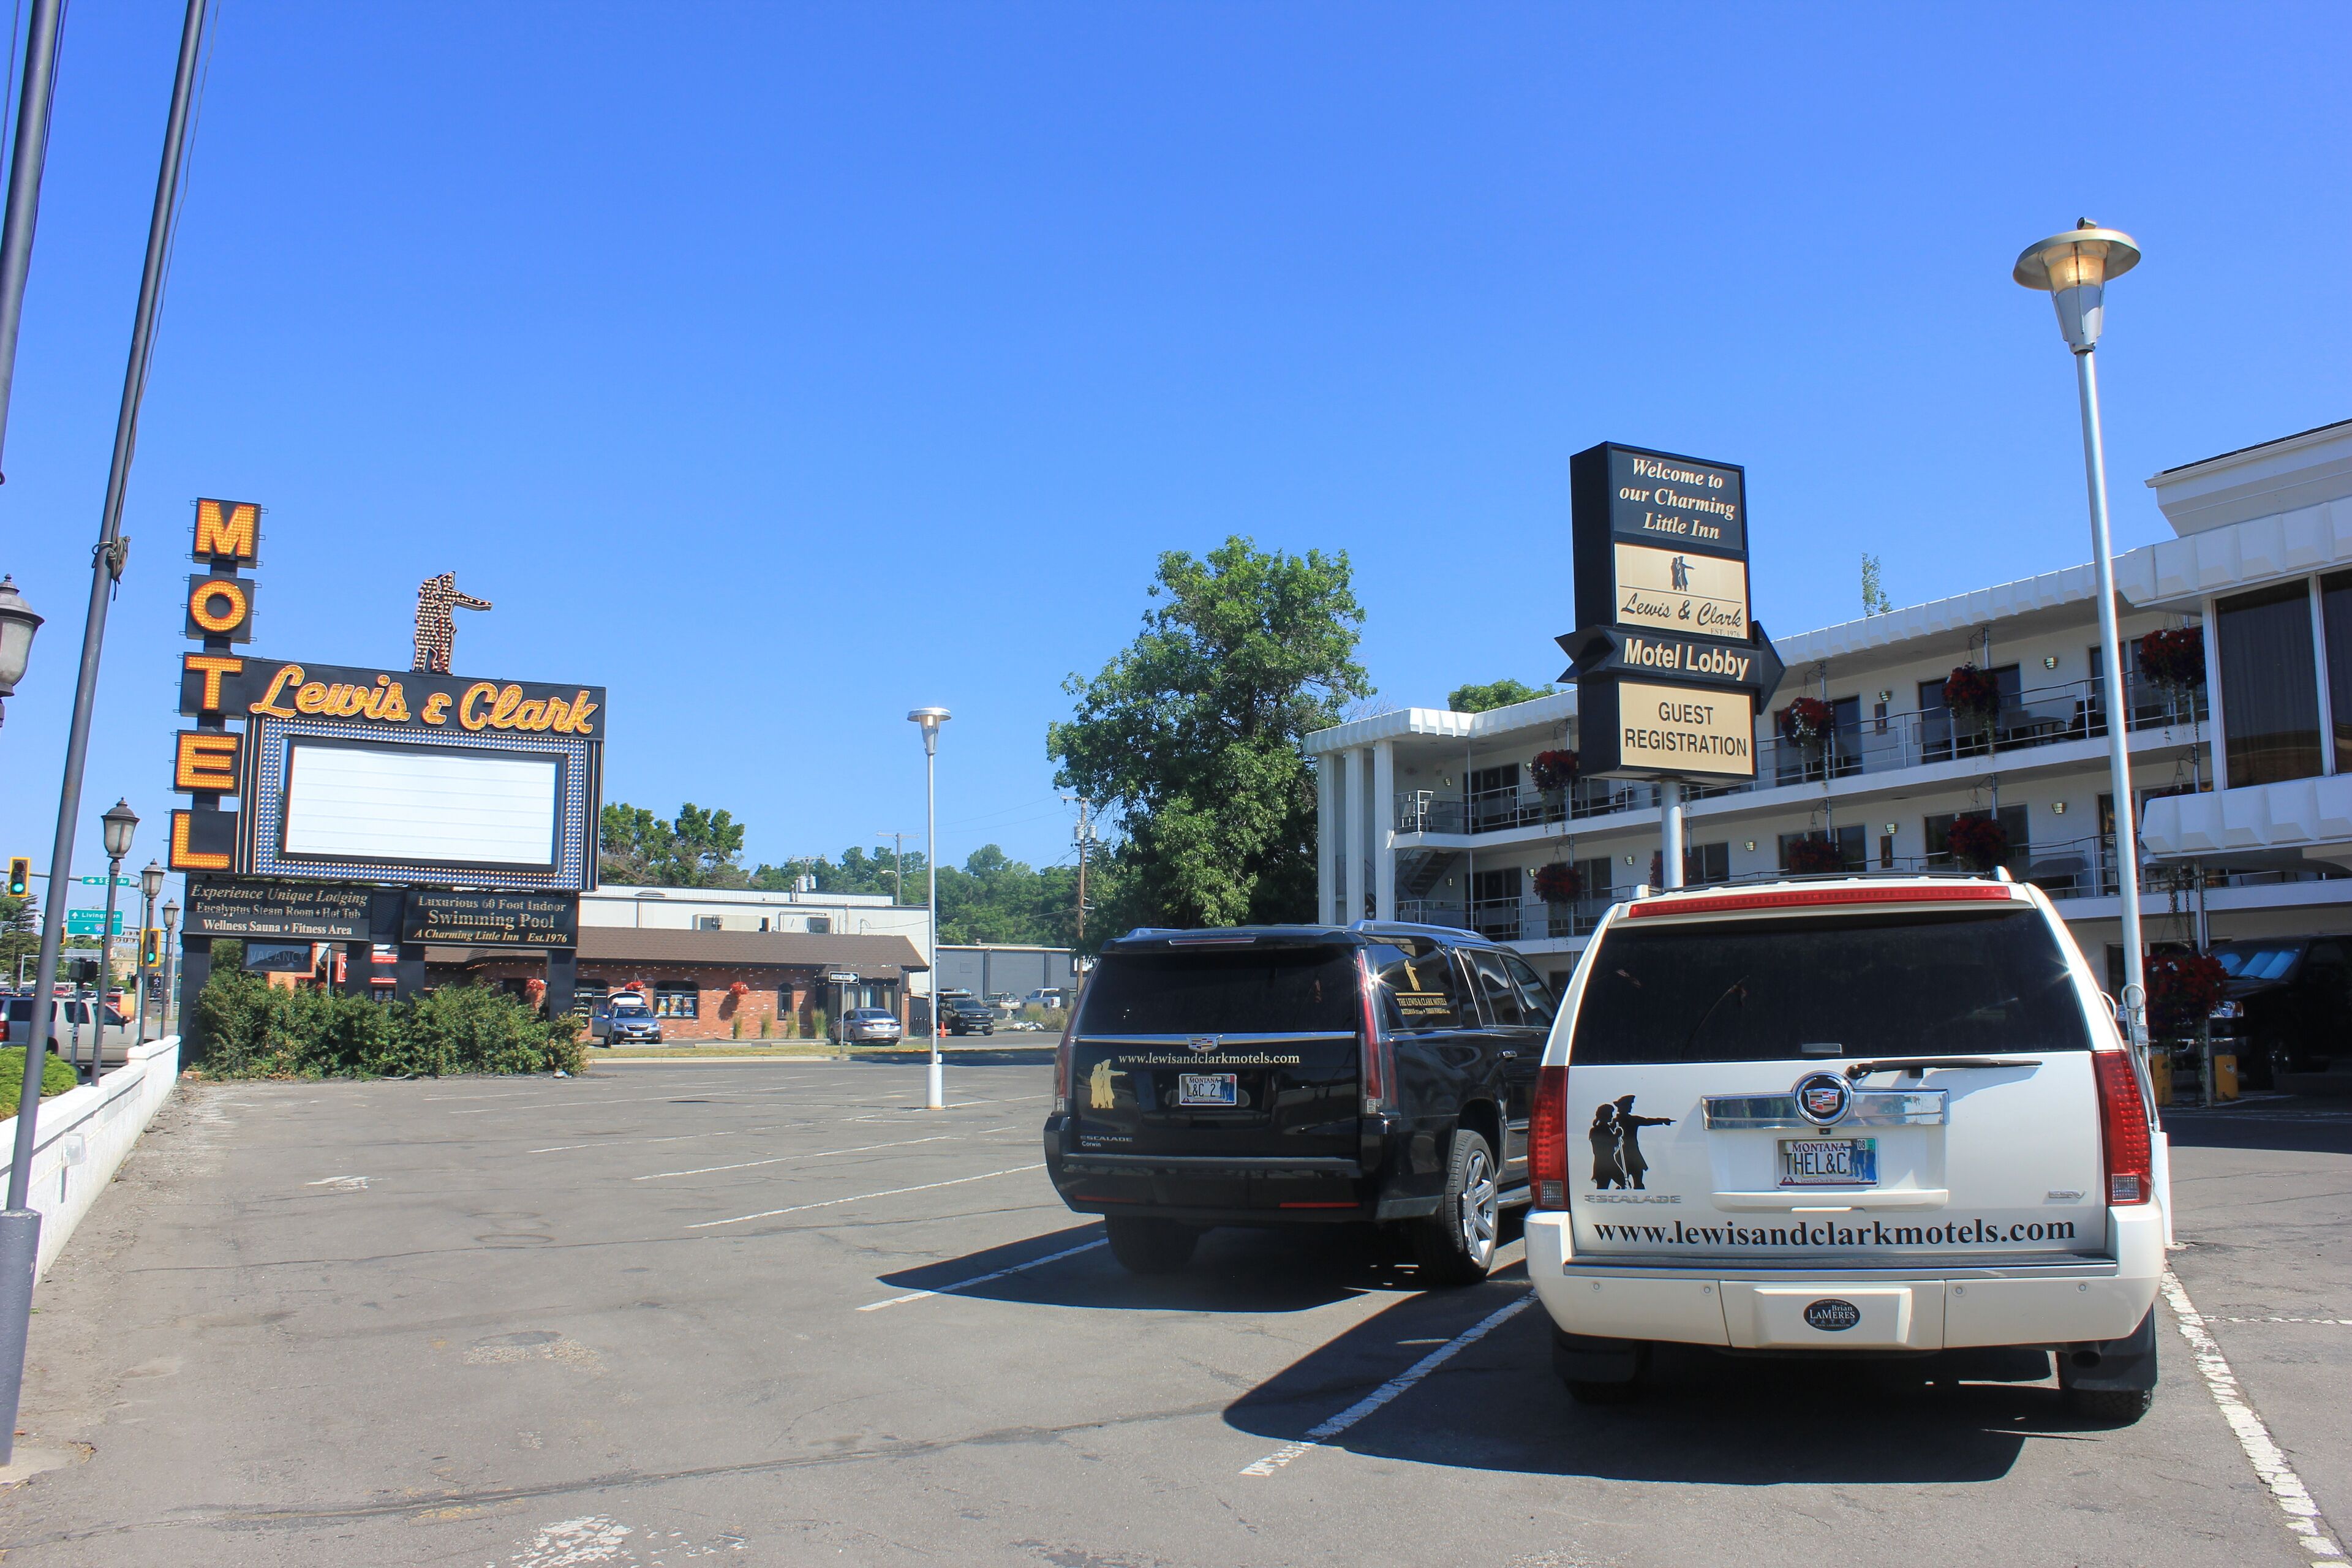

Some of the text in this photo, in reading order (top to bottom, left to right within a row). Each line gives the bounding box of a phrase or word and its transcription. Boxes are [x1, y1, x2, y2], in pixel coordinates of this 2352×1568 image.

[1633, 458, 1723, 489] Welcome to
[1619, 488, 1735, 521] our Charming
[1642, 512, 1720, 540] Little Inn
[1621, 592, 1743, 627] Lewis & Clark
[1624, 638, 1749, 681] Motel Lobby
[171, 500, 255, 869] MOTEL
[250, 665, 599, 734] Lewis & Clark
[1658, 702, 1713, 725] GUEST
[1625, 728, 1747, 757] REGISTRATION
[191, 884, 368, 907] Experience Unique Lodging
[418, 895, 566, 911] Luxurious 60 Foot Indoor
[197, 902, 360, 919] Eucalyptus Steam Room Hot Tub
[428, 910, 554, 930] Swimming Pool
[203, 919, 352, 935] Wellness Sauna Fitness Area
[414, 929, 423, 938] A
[425, 929, 473, 941] Charming
[475, 931, 500, 940] Little
[502, 932, 519, 941] Inn
[250, 950, 306, 962] VACANCY
[1118, 1052, 1300, 1065] www.lewisandclarkmotels.com
[1186, 1084, 1216, 1097] L&C 2
[1792, 1143, 1846, 1152] MONTANA
[1858, 1140, 1865, 1149] 08
[1783, 1152, 1847, 1175] THEL&C
[1584, 1195, 1681, 1204] ESCALADE
[1593, 1219, 2076, 1246] www.lewisandclarkmotels.com
